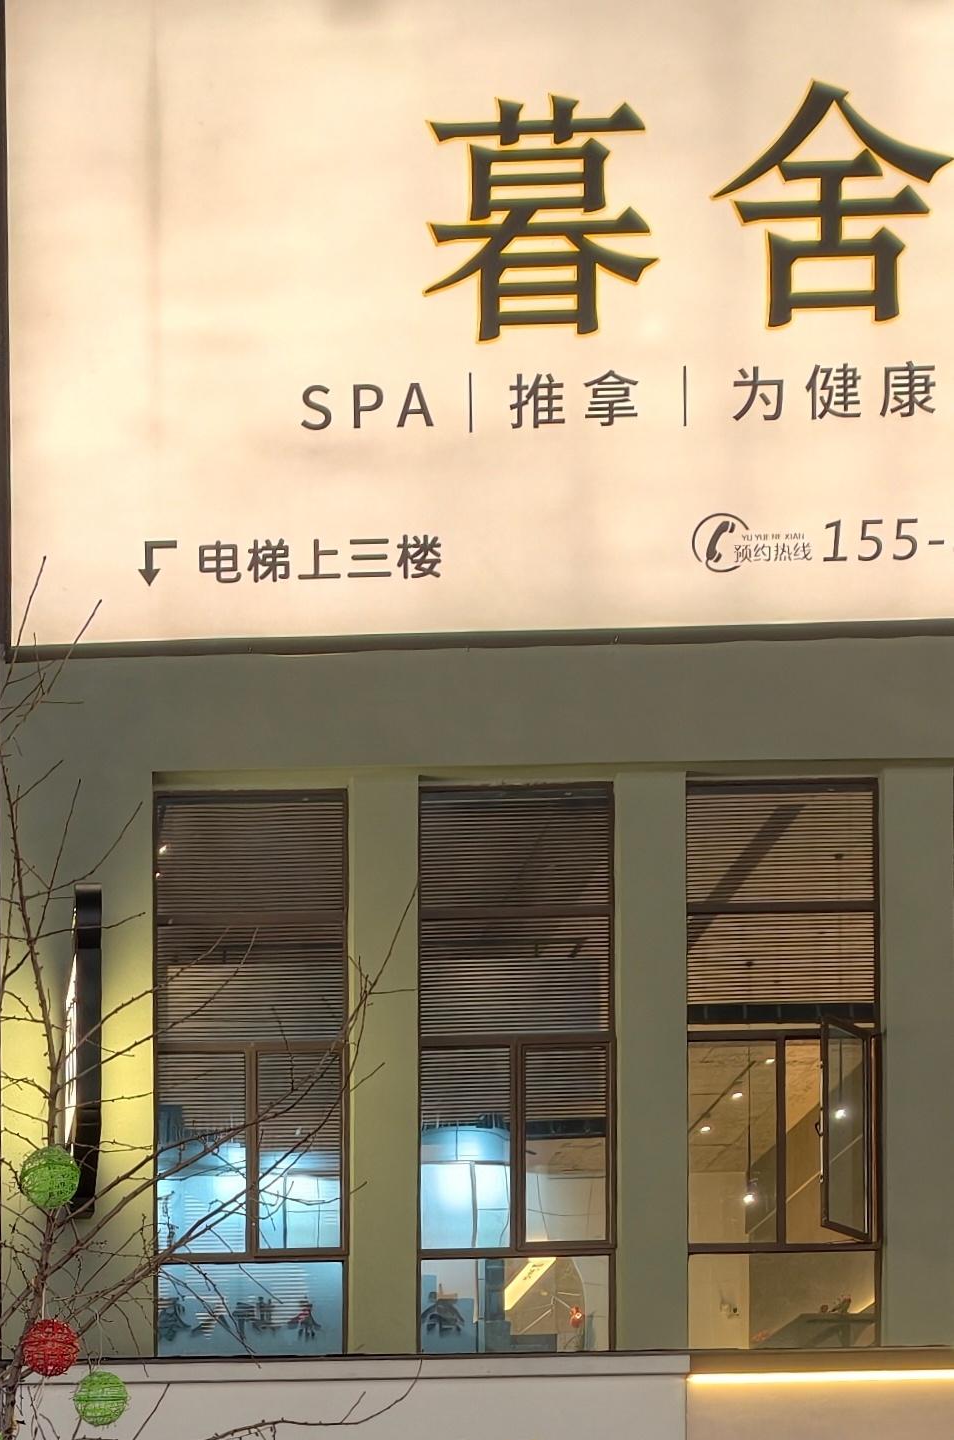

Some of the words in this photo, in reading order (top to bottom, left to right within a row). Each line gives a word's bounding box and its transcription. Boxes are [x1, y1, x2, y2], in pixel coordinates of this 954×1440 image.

[422, 79, 954, 344] 暮舍
[300, 382, 436, 431] SPA
[509, 368, 640, 429] 推拿
[731, 361, 938, 424] 为健康
[198, 533, 443, 585] 电梯上三楼
[734, 542, 813, 563] 预约热线
